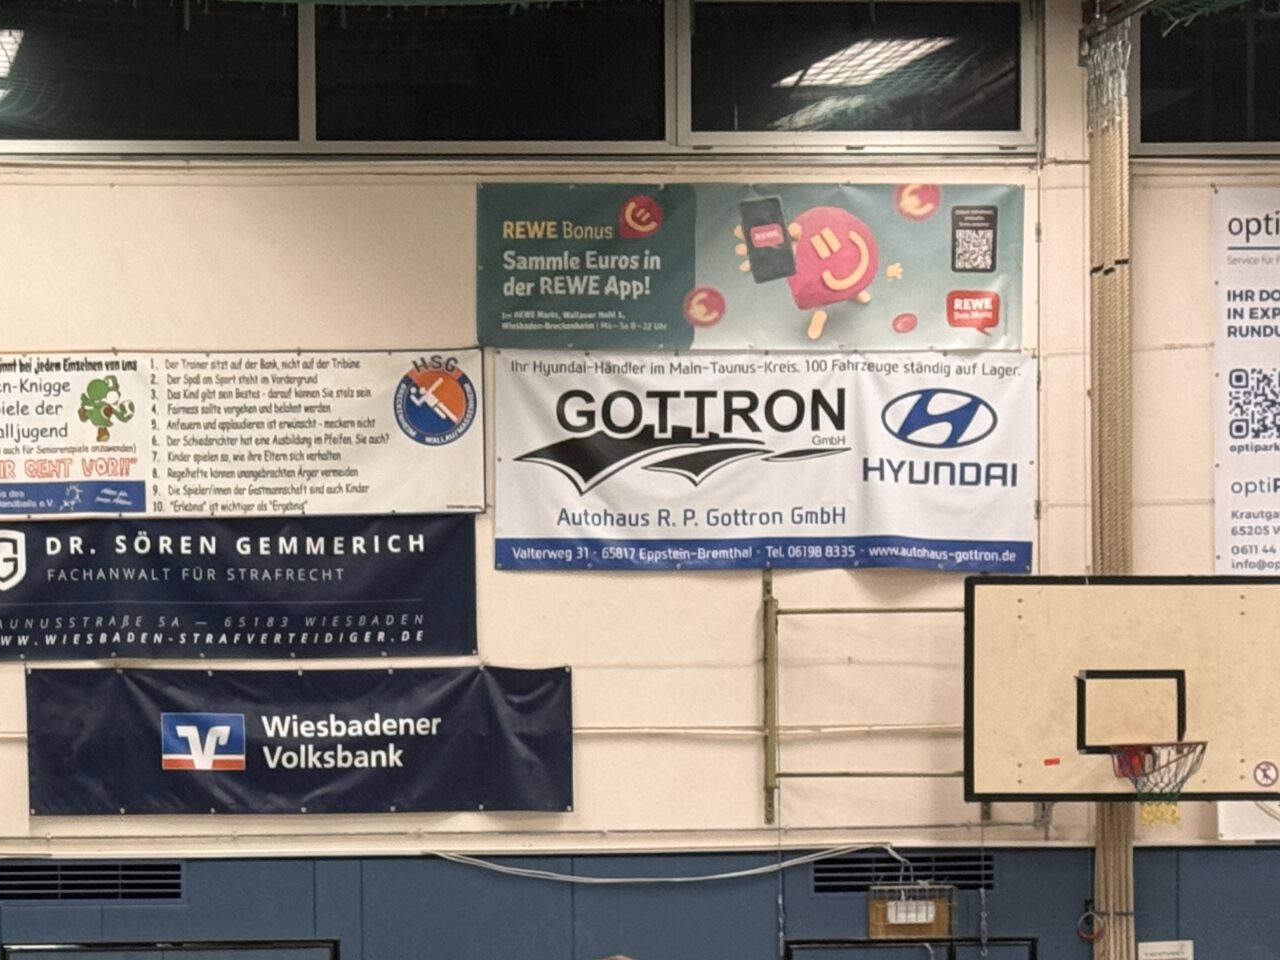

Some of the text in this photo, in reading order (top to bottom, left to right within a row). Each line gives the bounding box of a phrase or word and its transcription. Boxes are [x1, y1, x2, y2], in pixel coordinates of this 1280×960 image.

[502, 221, 613, 240] REWE Bonus
[503, 250, 661, 271] Sammle Euros in
[503, 275, 651, 299] der REWE App!
[1227, 289, 1255, 302] IHR
[954, 298, 992, 310] REWE
[1227, 307, 1244, 320] IN
[19, 358, 32, 371] bei
[34, 358, 61, 375] jedem
[63, 357, 102, 372] Einzelnen
[105, 359, 120, 371] von
[122, 359, 137, 371] uns
[165, 358, 179, 370] Der
[181, 358, 208, 370] Trainer
[210, 359, 228, 370] sitzt
[230, 357, 243, 370] auf
[245, 359, 258, 370] der
[281, 358, 301, 370] nicht
[302, 358, 315, 370] auf
[317, 358, 330, 370] der
[331, 357, 361, 369] Tribüne
[411, 354, 459, 373] HSG
[511, 359, 1021, 380] Ihr Hyundai-Händler im Main-Taunus-Kreis. 100 Fahrzeuge ständig auf Lager.
[35, 400, 63, 417] der
[556, 387, 846, 438] GOTTRON
[812, 435, 846, 446] GmbH
[25, 459, 72, 478] GEHT
[862, 457, 1018, 488] HYUNDAI
[556, 506, 846, 528] Autohaus R. P. Gottron GmbH
[1231, 525, 1270, 536] 65205
[46, 531, 425, 556] DR. SÖREN GEMMERICH
[512, 545, 1016, 562] Valterweg 31 65817 Eppstein-Bremthal Tel. 06198 8335 www.autohaus-gottron.de
[47, 565, 345, 582] FACHANWALT FÜR STRAFRECHT
[158, 616, 180, 628] 5A
[224, 616, 289, 628] 65183
[305, 614, 424, 628] WIESBADEN
[261, 713, 442, 739] Wiesbadener
[262, 743, 404, 769] Volksbank
